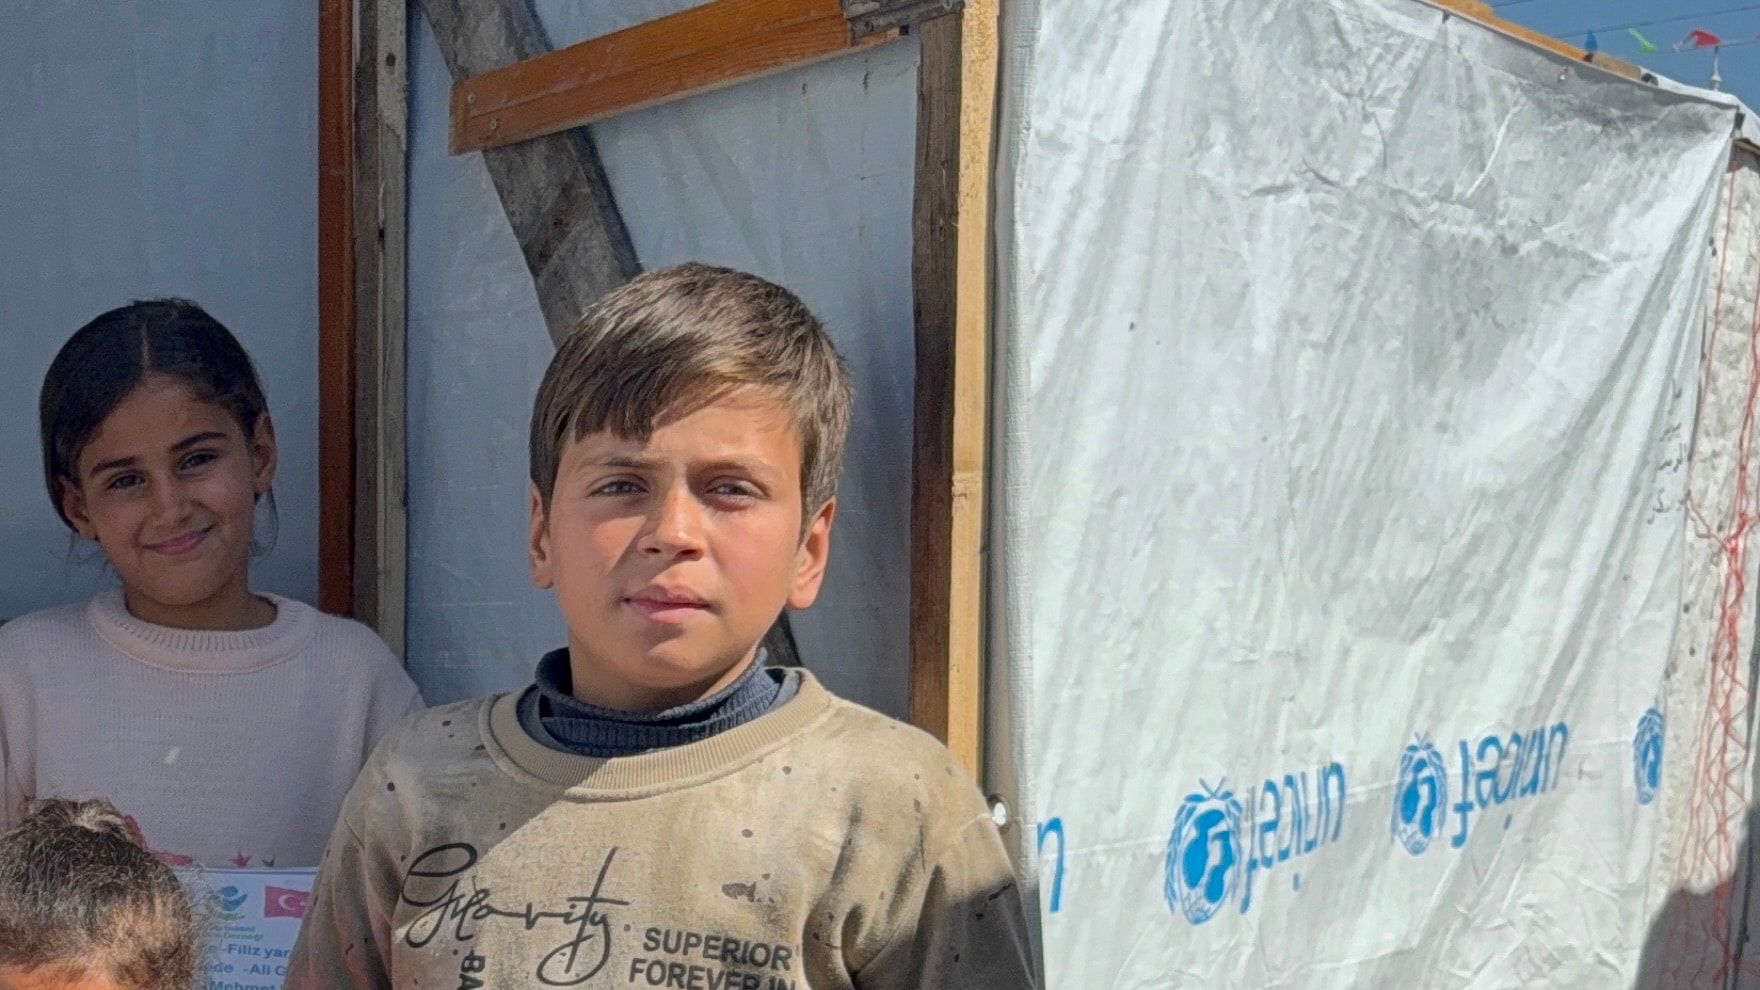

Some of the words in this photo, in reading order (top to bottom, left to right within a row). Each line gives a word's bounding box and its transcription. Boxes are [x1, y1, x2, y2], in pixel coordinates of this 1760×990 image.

[1451, 721, 1569, 849] unicef
[264, 949, 290, 960] yar
[643, 927, 792, 970] SUPERIOR
